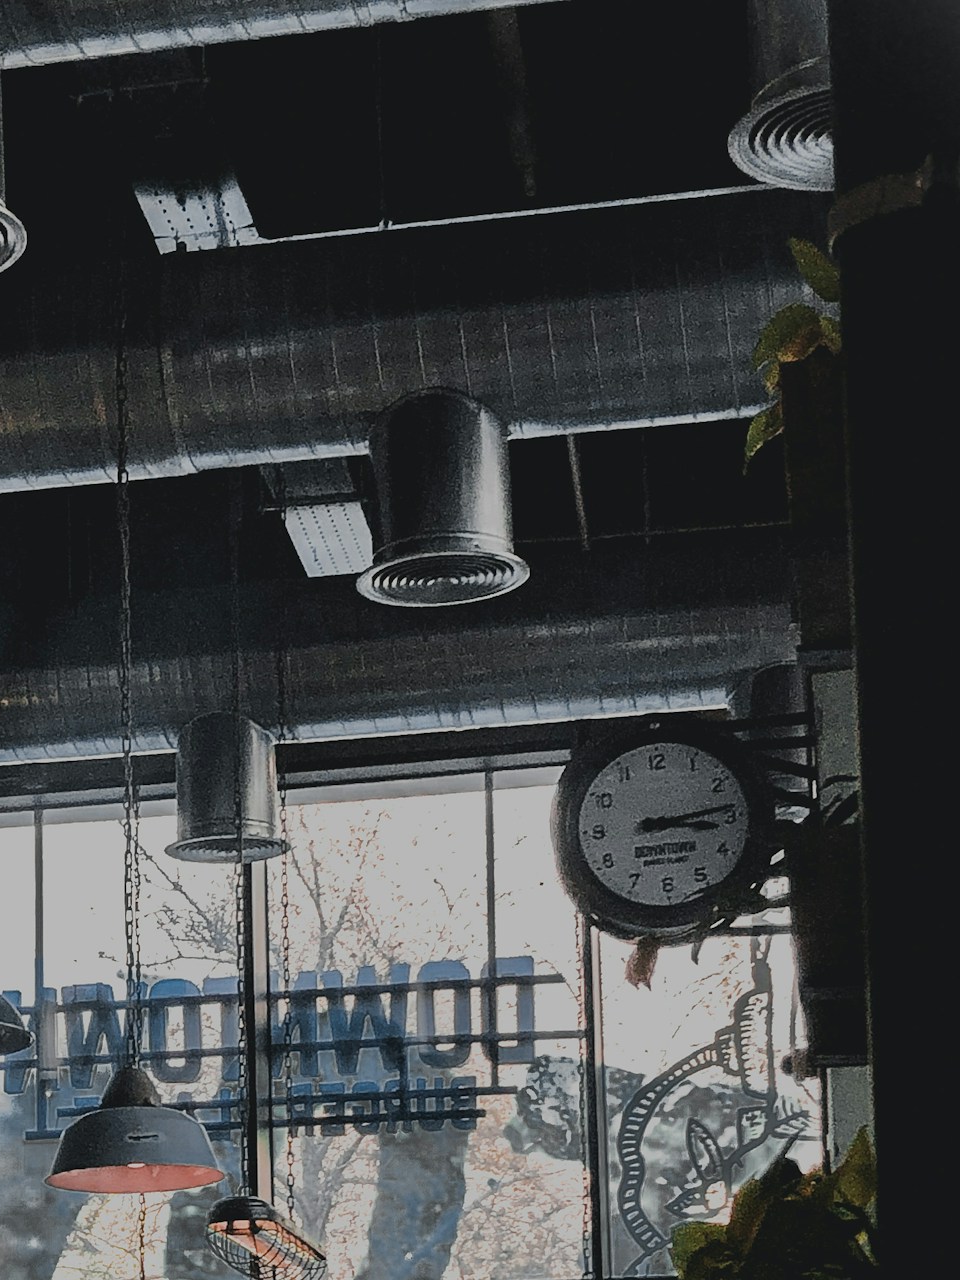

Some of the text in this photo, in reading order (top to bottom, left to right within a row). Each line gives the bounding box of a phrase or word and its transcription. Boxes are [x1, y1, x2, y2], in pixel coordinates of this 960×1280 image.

[648, 753, 666, 771] 12
[711, 777, 725, 793] 2
[724, 807, 737, 825] 3
[592, 824, 606, 840] 9
[716, 841, 730, 857] 4
[602, 853, 614, 868] 8
[629, 872, 641, 889] 7
[694, 866, 708, 882] 5
[661, 877, 674, 892] 6
